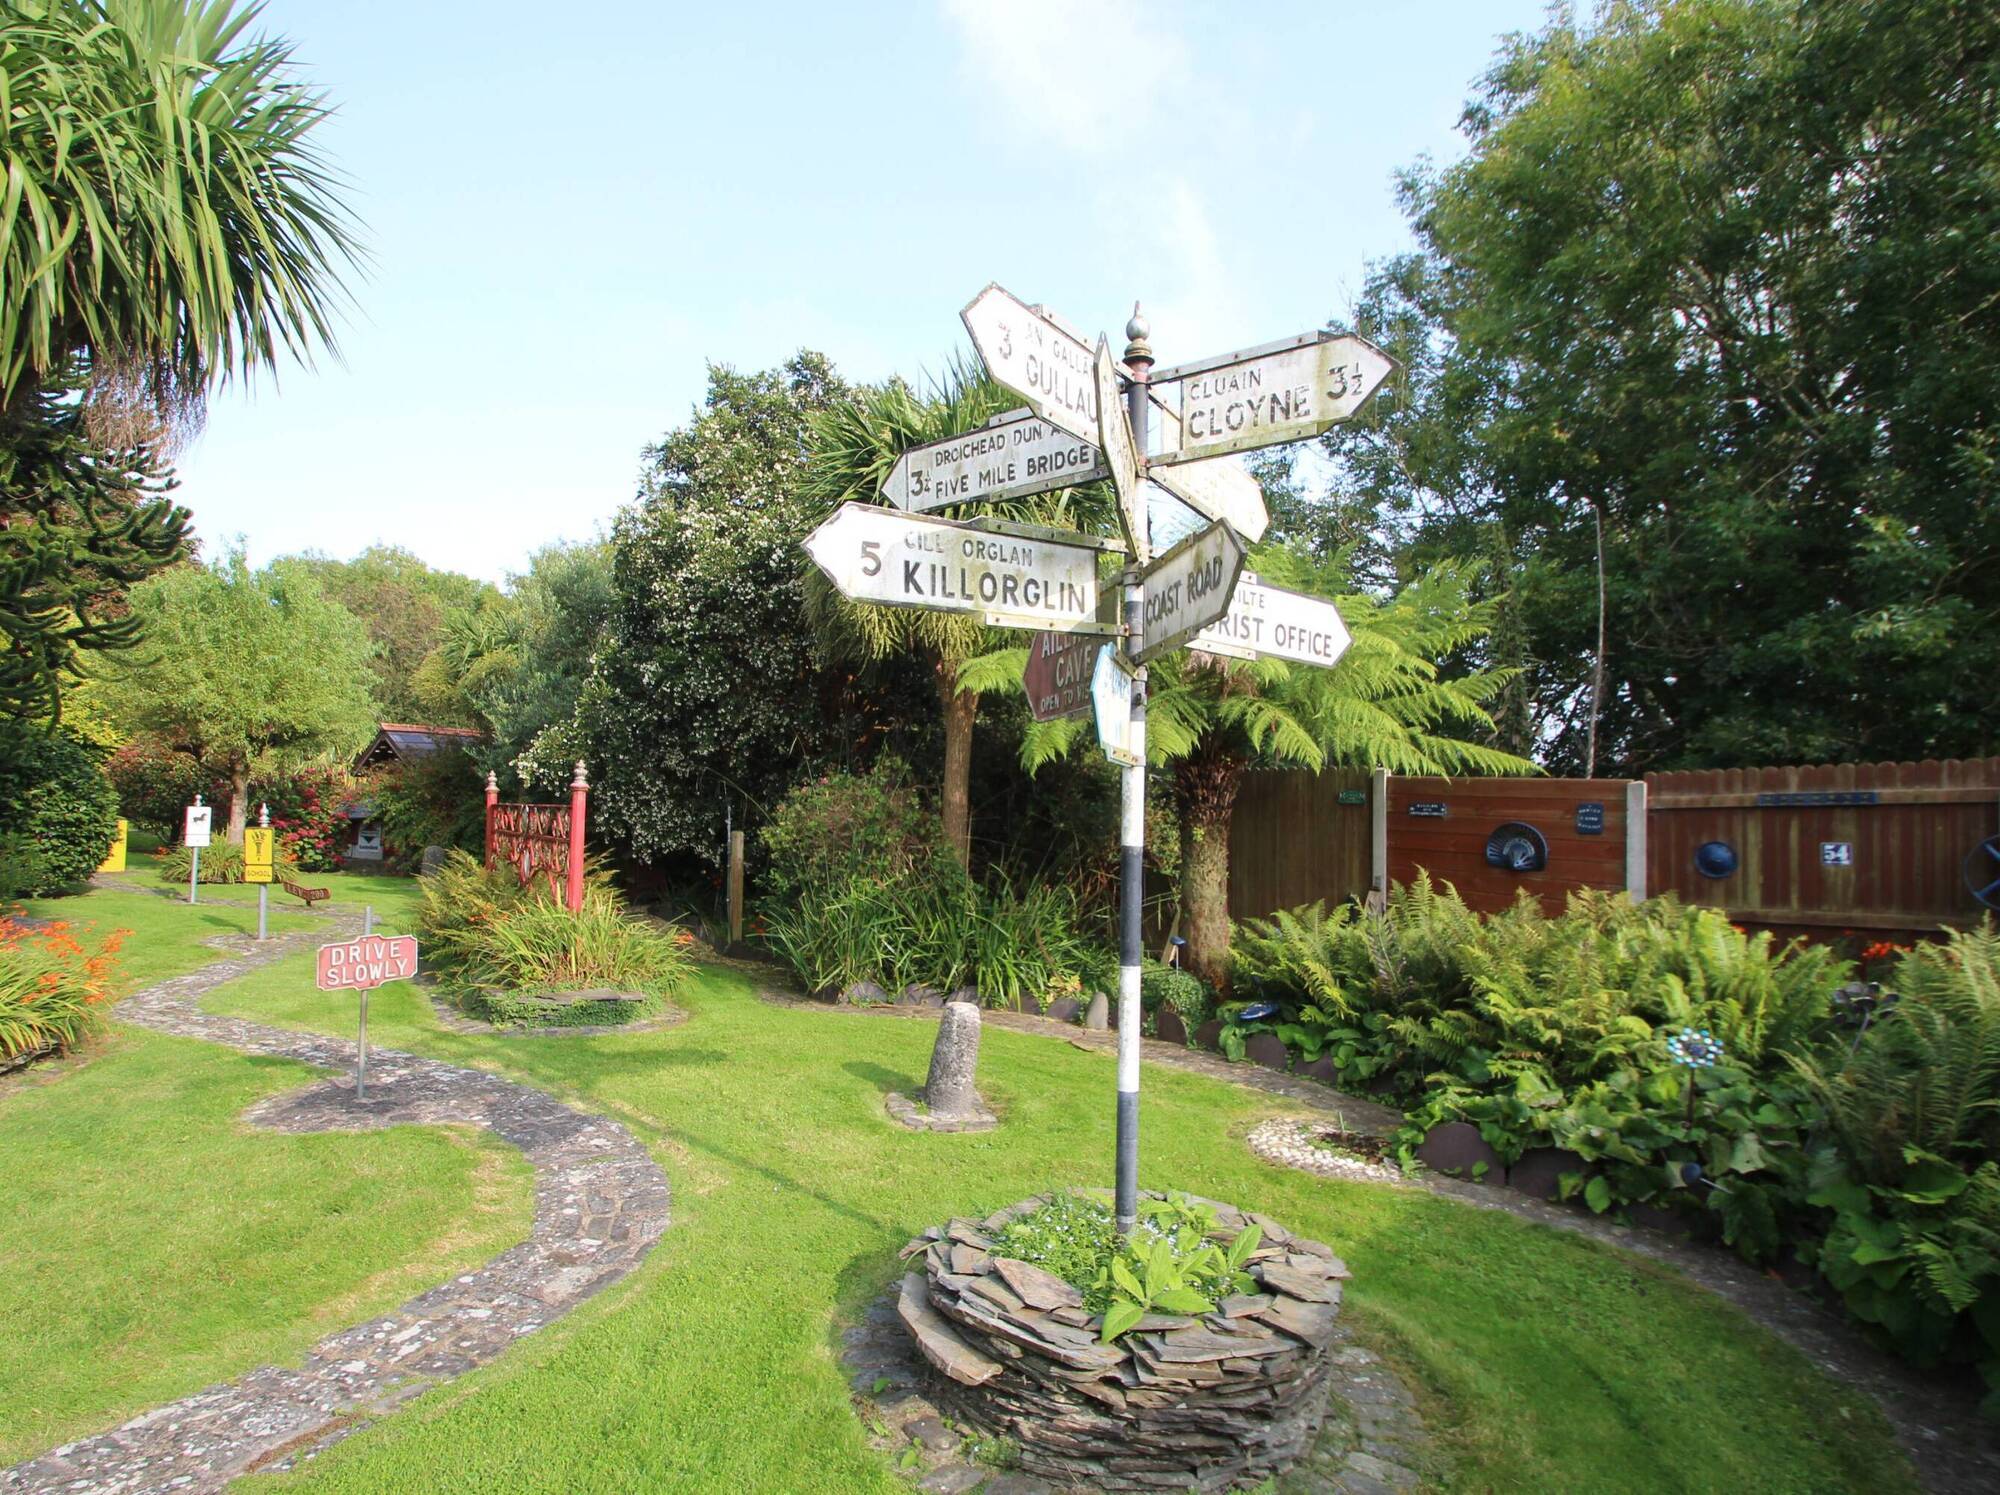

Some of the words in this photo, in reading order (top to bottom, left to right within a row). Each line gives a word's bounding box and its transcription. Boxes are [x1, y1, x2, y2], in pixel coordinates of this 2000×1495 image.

[998, 321, 1012, 360] 3
[1026, 354, 1098, 424] GULLAU
[1189, 384, 1311, 439] CLOYNE
[935, 434, 1006, 467] DROICHEAD
[1013, 424, 1042, 446] DUN
[936, 474, 969, 499] FIVE
[979, 463, 1016, 488] MILE
[1027, 444, 1090, 477] BRIDGE
[860, 540, 882, 577] 5
[962, 538, 1033, 567] ORGLAN
[903, 560, 1086, 614] KILLORGLIN
[1146, 579, 1183, 626] COAST
[1187, 556, 1223, 604] ROAD
[1275, 623, 1333, 658] OFFICE
[1056, 645, 1092, 688] CAVE
[1040, 693, 1060, 713] OPEN
[1064, 688, 1074, 705] TO
[1823, 844, 1849, 861] 54
[247, 869, 271, 878] SCHOOL
[326, 958, 408, 986] SLOWLY
[331, 941, 403, 966] DRIVE
